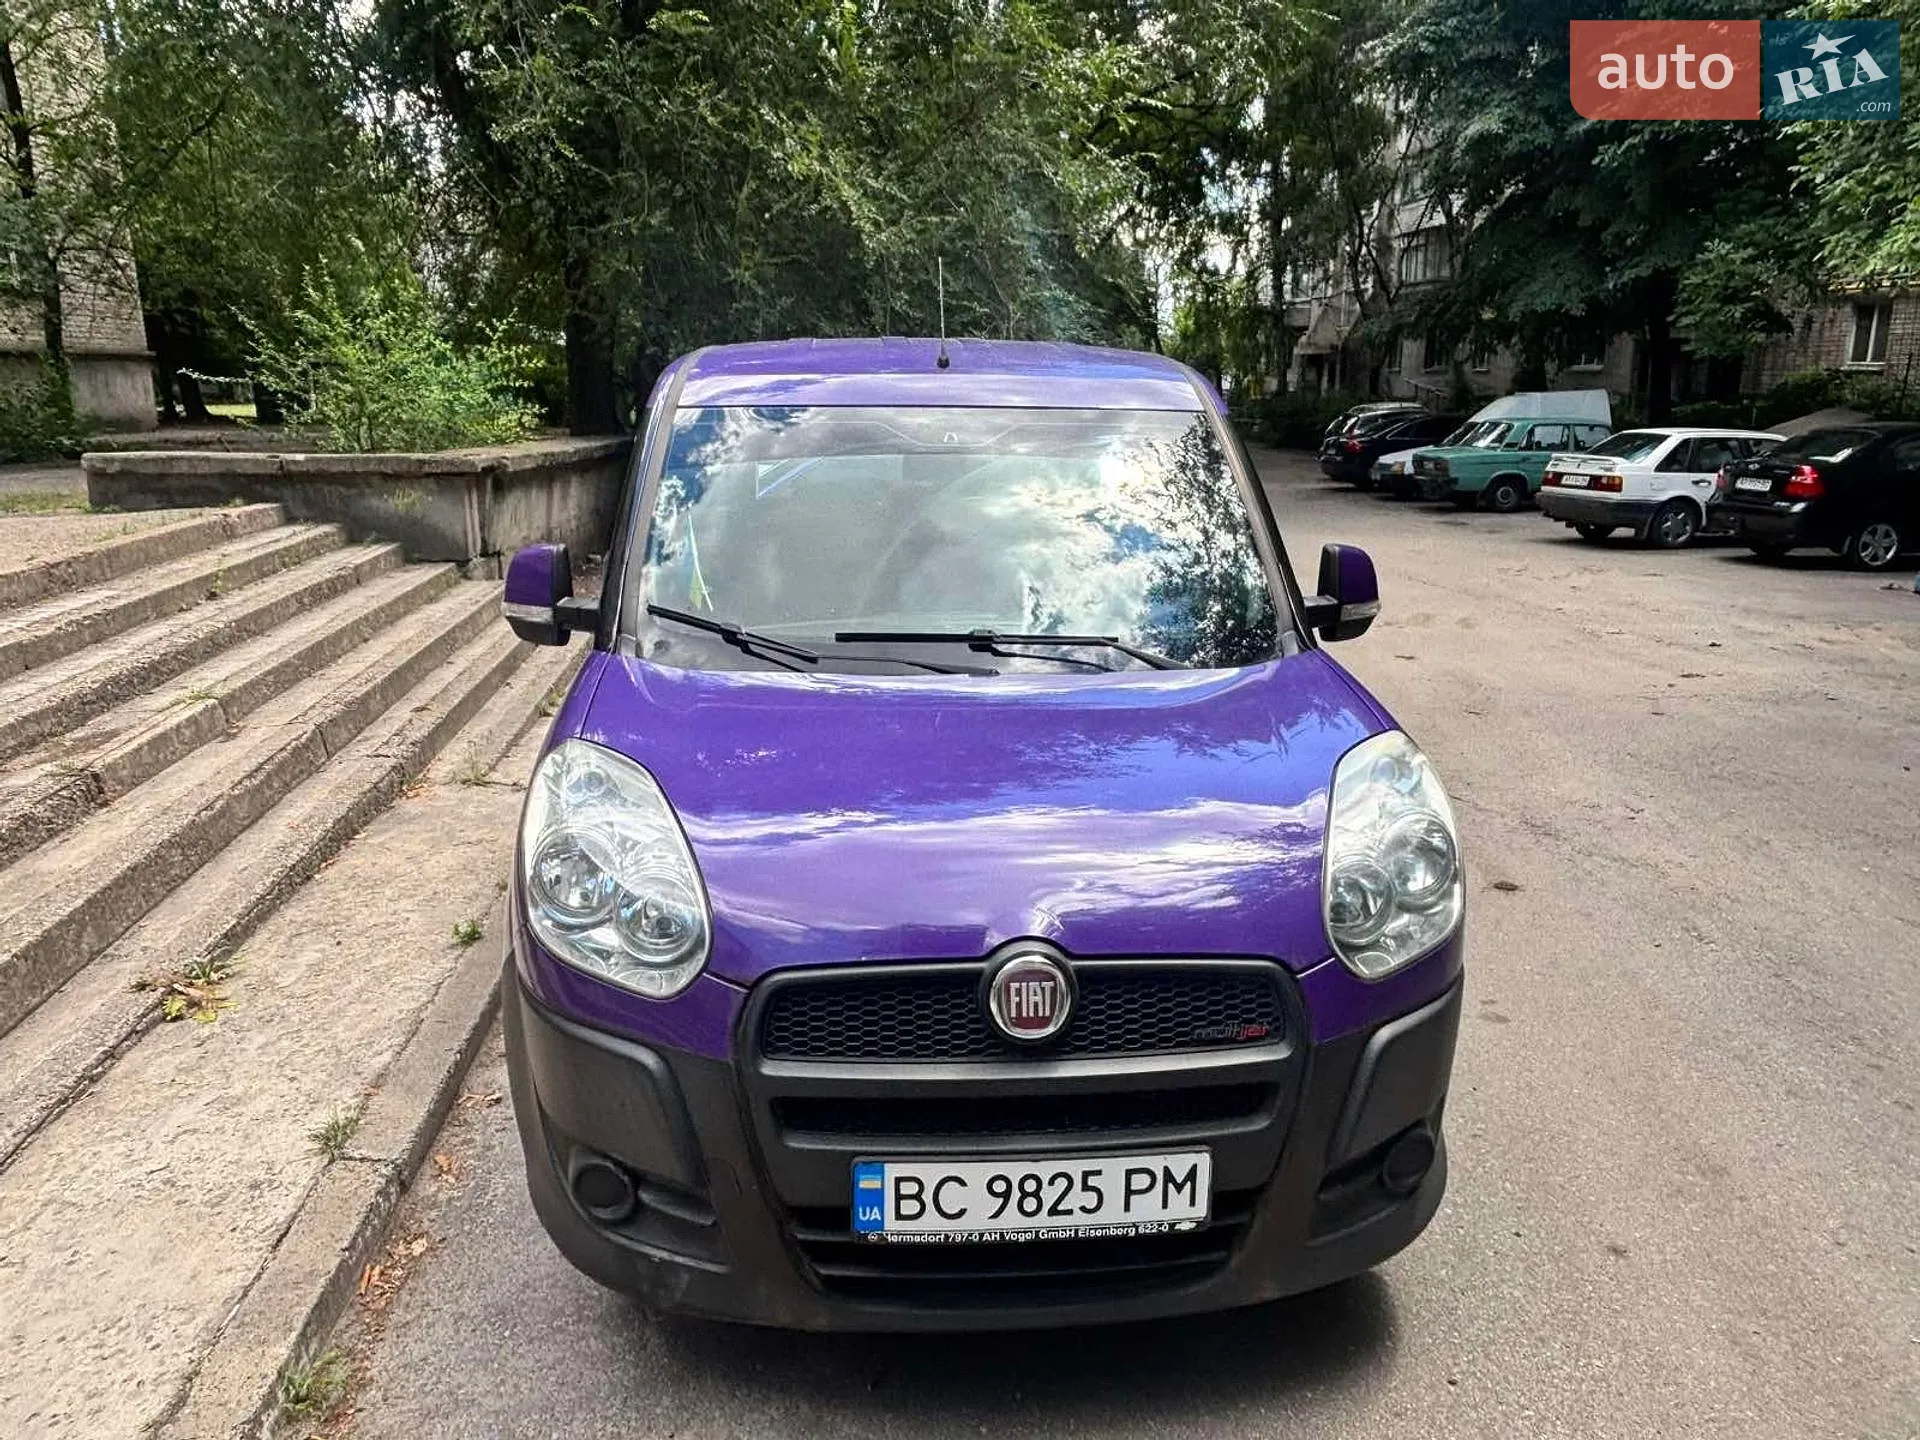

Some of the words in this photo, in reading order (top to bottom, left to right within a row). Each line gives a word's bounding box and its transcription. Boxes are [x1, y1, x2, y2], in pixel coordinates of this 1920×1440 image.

[1009, 981, 1055, 1018] FIAT
[894, 1175, 968, 1221] BC
[985, 1169, 1104, 1220] 9825
[1123, 1163, 1198, 1213] PM
[859, 1206, 882, 1221] UA
[1038, 1227, 1075, 1240] GmbH
